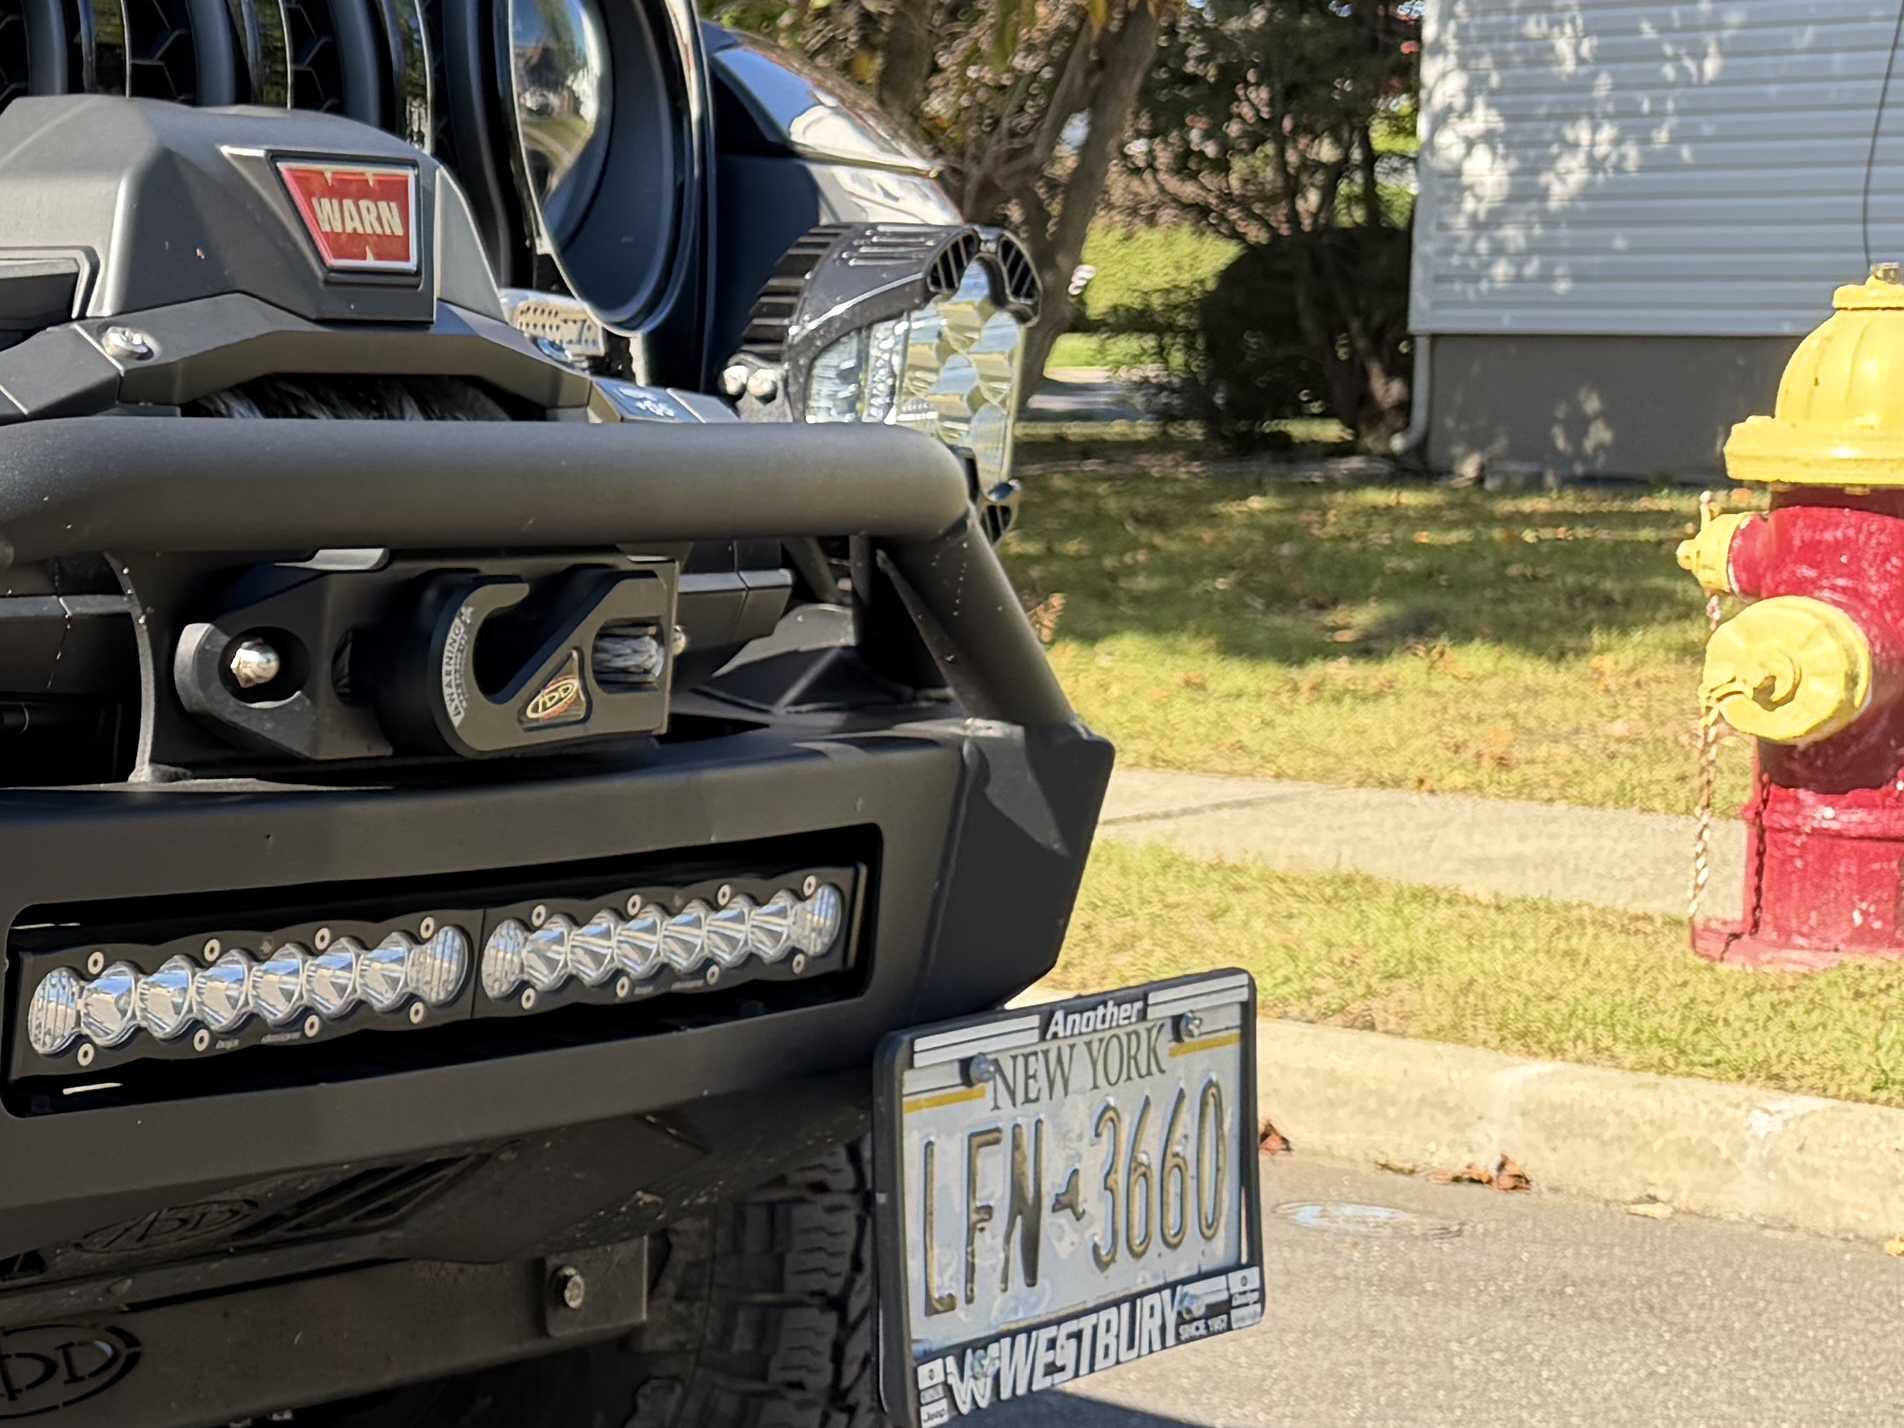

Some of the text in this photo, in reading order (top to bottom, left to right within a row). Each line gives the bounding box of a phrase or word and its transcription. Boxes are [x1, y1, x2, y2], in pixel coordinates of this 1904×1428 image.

[311, 197, 404, 236] WARN
[444, 623, 463, 705] WARNING
[1045, 999, 1144, 1040] Another
[990, 1022, 1167, 1112] NEW YORK
[924, 1074, 1228, 1317] LFN 3660
[999, 1284, 1183, 1401] WESTBURY
